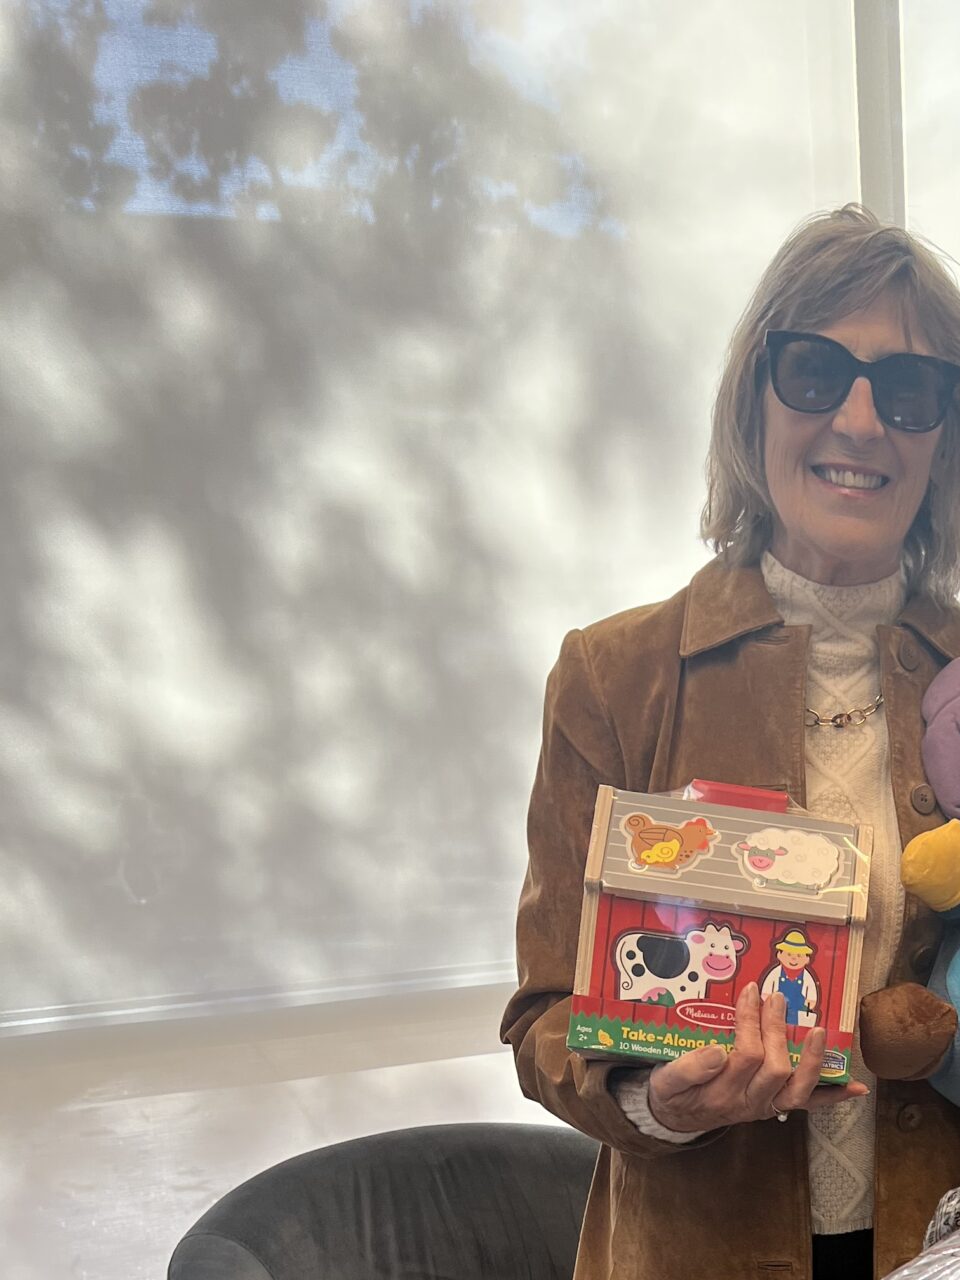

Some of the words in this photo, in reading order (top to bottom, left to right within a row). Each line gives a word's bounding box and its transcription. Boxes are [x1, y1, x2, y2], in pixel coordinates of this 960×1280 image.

[576, 1024, 593, 1033] Ages
[621, 1026, 706, 1050] Take-Along
[619, 1041, 629, 1050] 10
[631, 1044, 662, 1055] Wooden
[663, 1048, 680, 1059] Play
